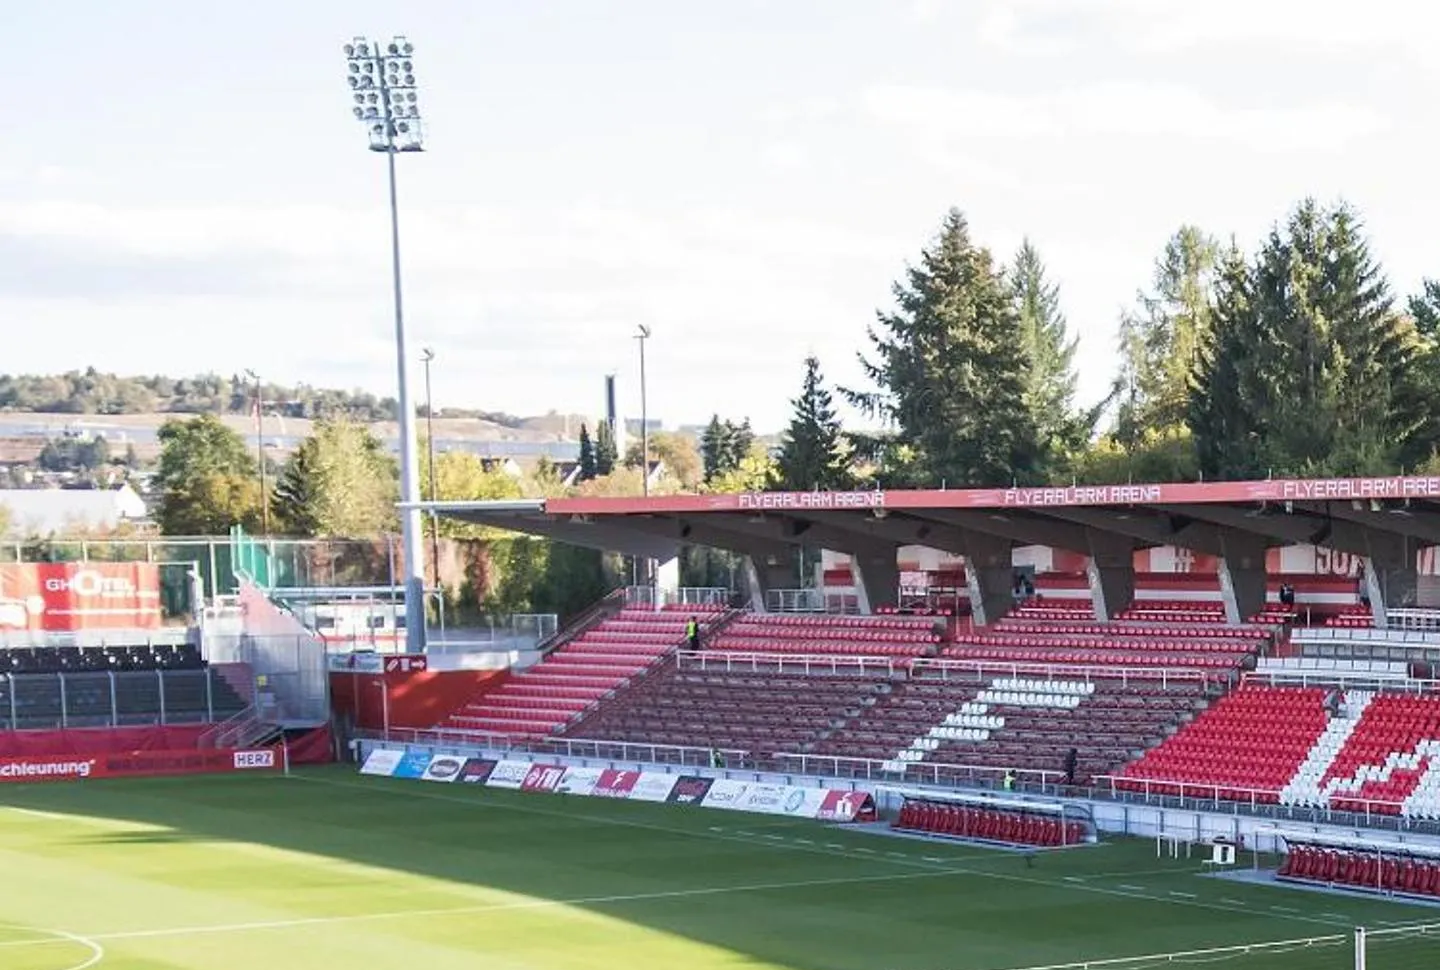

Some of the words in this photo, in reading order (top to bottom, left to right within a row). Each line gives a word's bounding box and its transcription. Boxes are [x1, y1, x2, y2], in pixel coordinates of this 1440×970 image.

[1005, 486, 1107, 505] FLYERALARM
[1111, 485, 1161, 502] ARENA
[1283, 479, 1399, 498] FLYERALARM
[738, 493, 832, 508] FLYERALARM
[834, 491, 885, 506] ARENA
[237, 752, 272, 766] HERZ
